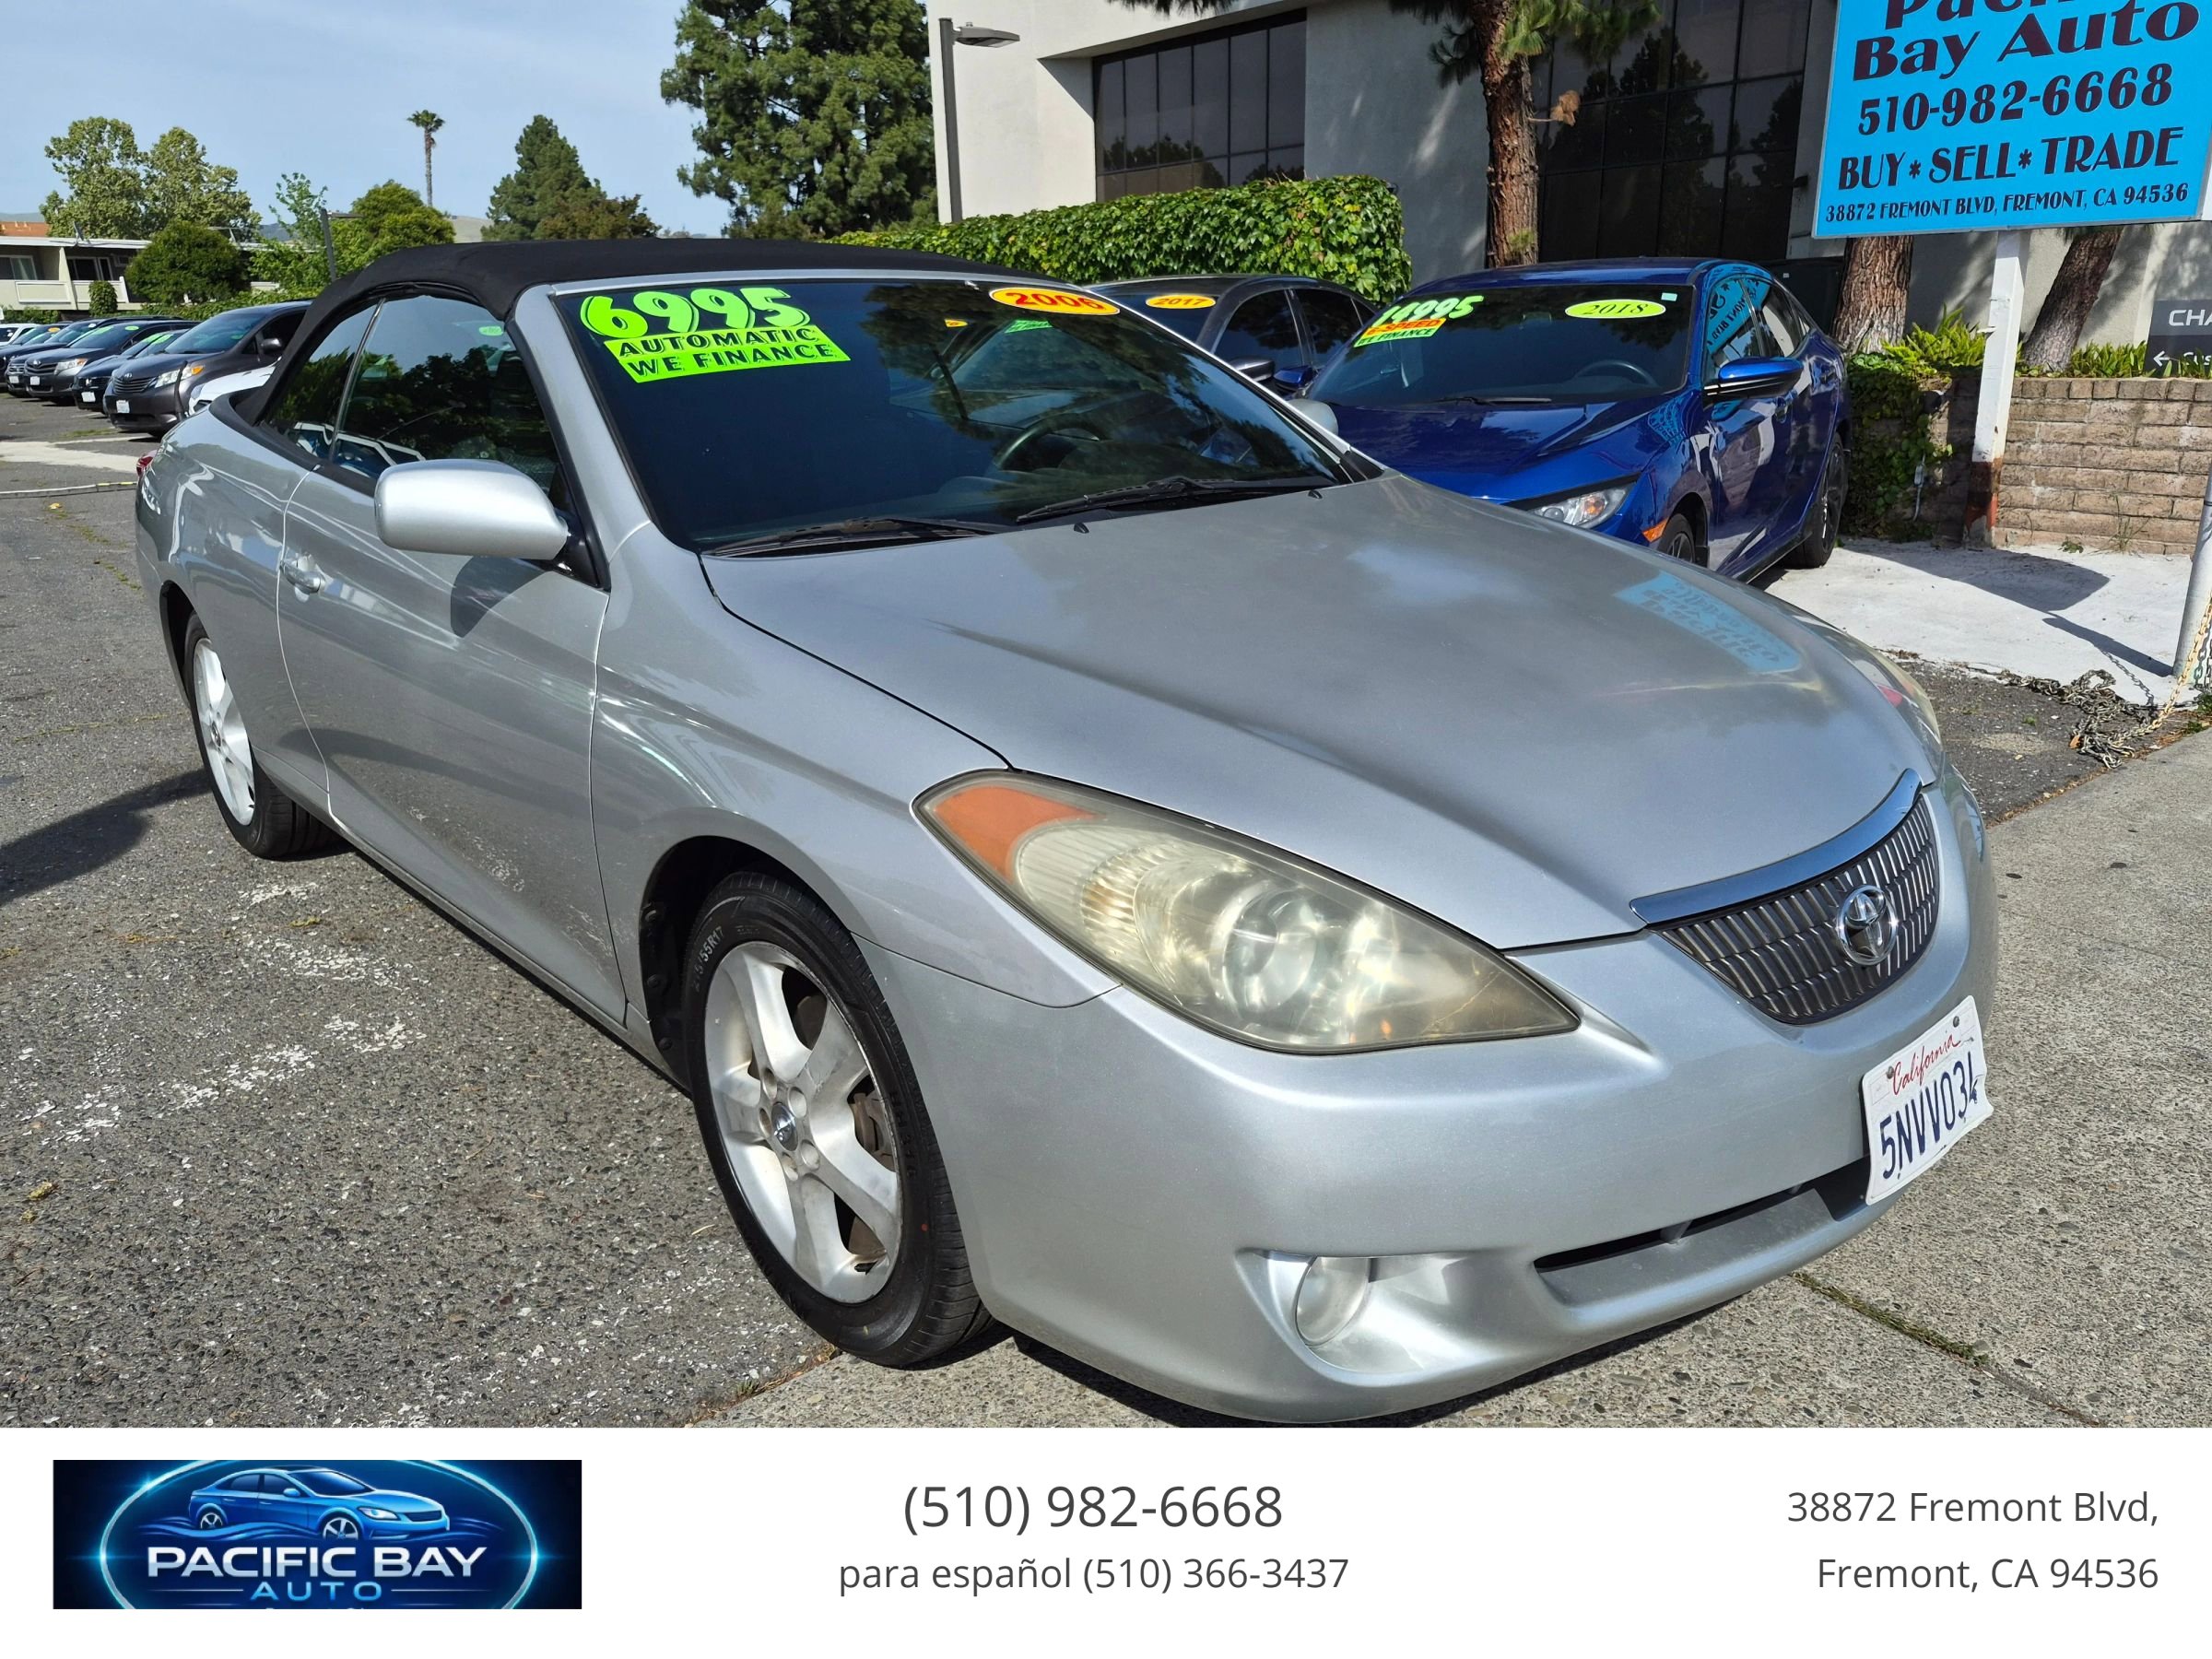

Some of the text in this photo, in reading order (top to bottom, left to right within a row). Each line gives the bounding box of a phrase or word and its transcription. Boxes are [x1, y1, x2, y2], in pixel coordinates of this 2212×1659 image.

[1853, 30, 1981, 81] Bay
[1996, 2, 2200, 62] Auto
[1858, 63, 2172, 135] 510-982-6668
[1838, 126, 2184, 190] BUY SELL TRADE
[1826, 182, 2188, 222] 38872 FREMONT BLVD, FREMONT, CA 94536
[580, 288, 811, 339] 6995
[1005, 291, 1104, 311] 2006
[1155, 298, 1206, 307] 2017
[1371, 295, 1484, 328] 14995
[1582, 303, 1649, 315] 2018
[618, 327, 817, 358] AUTOMATIC
[627, 344, 835, 376] WE FINANCE
[1892, 1033, 1961, 1095] California
